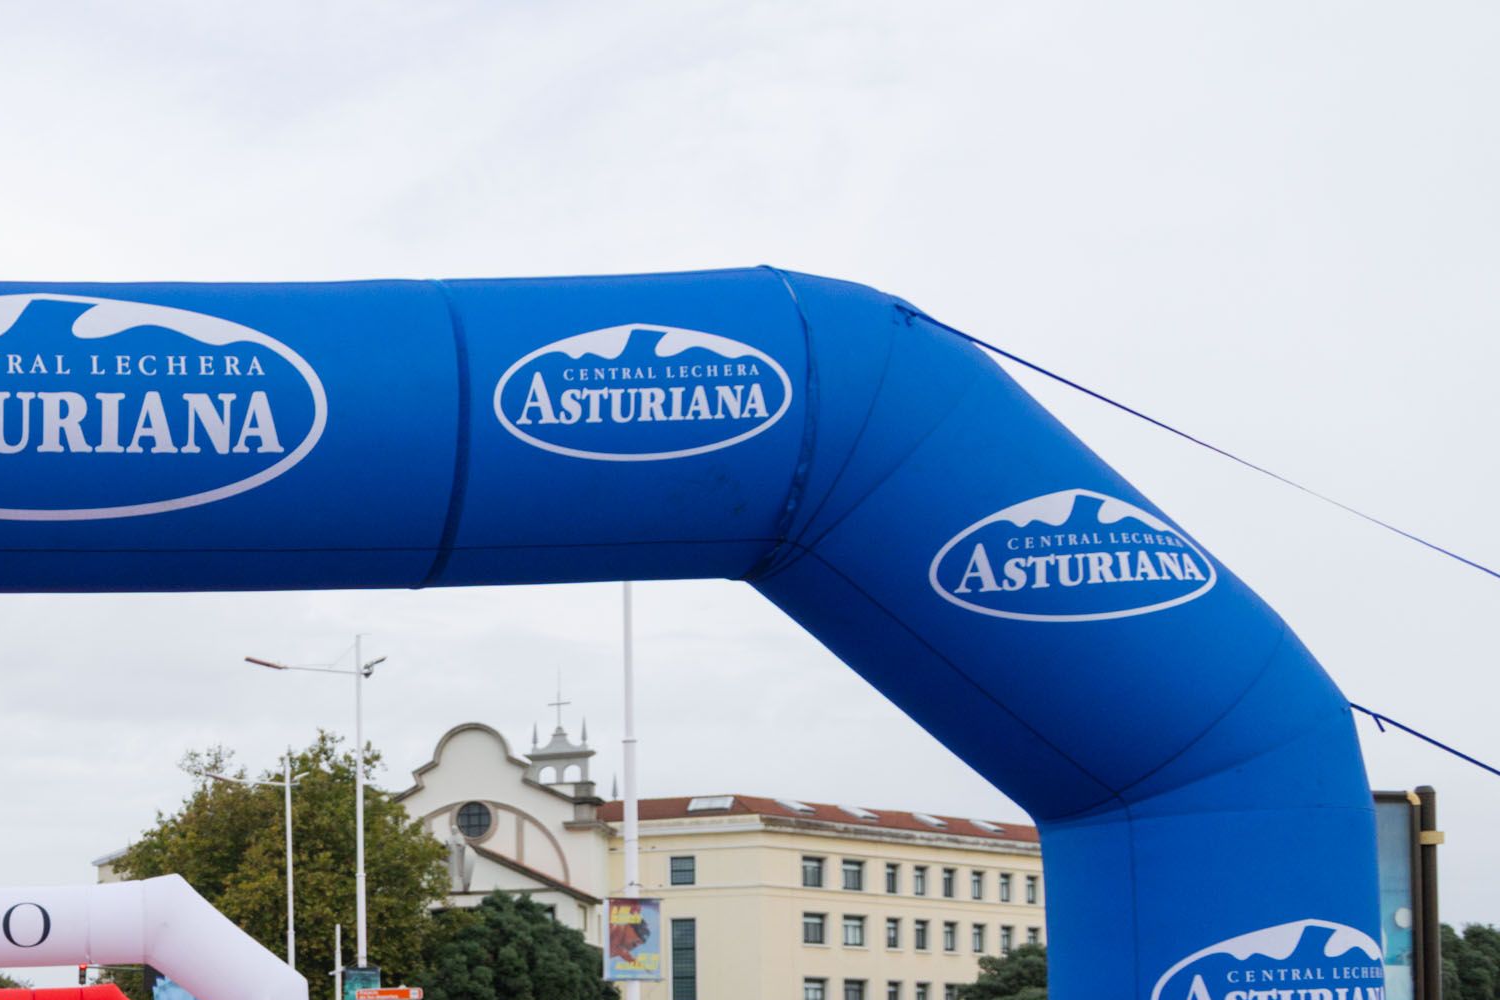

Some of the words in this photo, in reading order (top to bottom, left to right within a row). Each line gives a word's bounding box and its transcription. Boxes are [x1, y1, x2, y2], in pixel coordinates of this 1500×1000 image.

[90, 353, 266, 377] LECHERA
[563, 367, 656, 383] CENTRAL
[666, 364, 760, 380] LECHERA
[516, 371, 769, 427] ASTURIANA
[1007, 532, 1103, 551] CENTRAL
[1109, 531, 1184, 549] LECHERA
[953, 542, 1207, 594] ASTURIANA
[1226, 967, 1325, 984] CENTRAL
